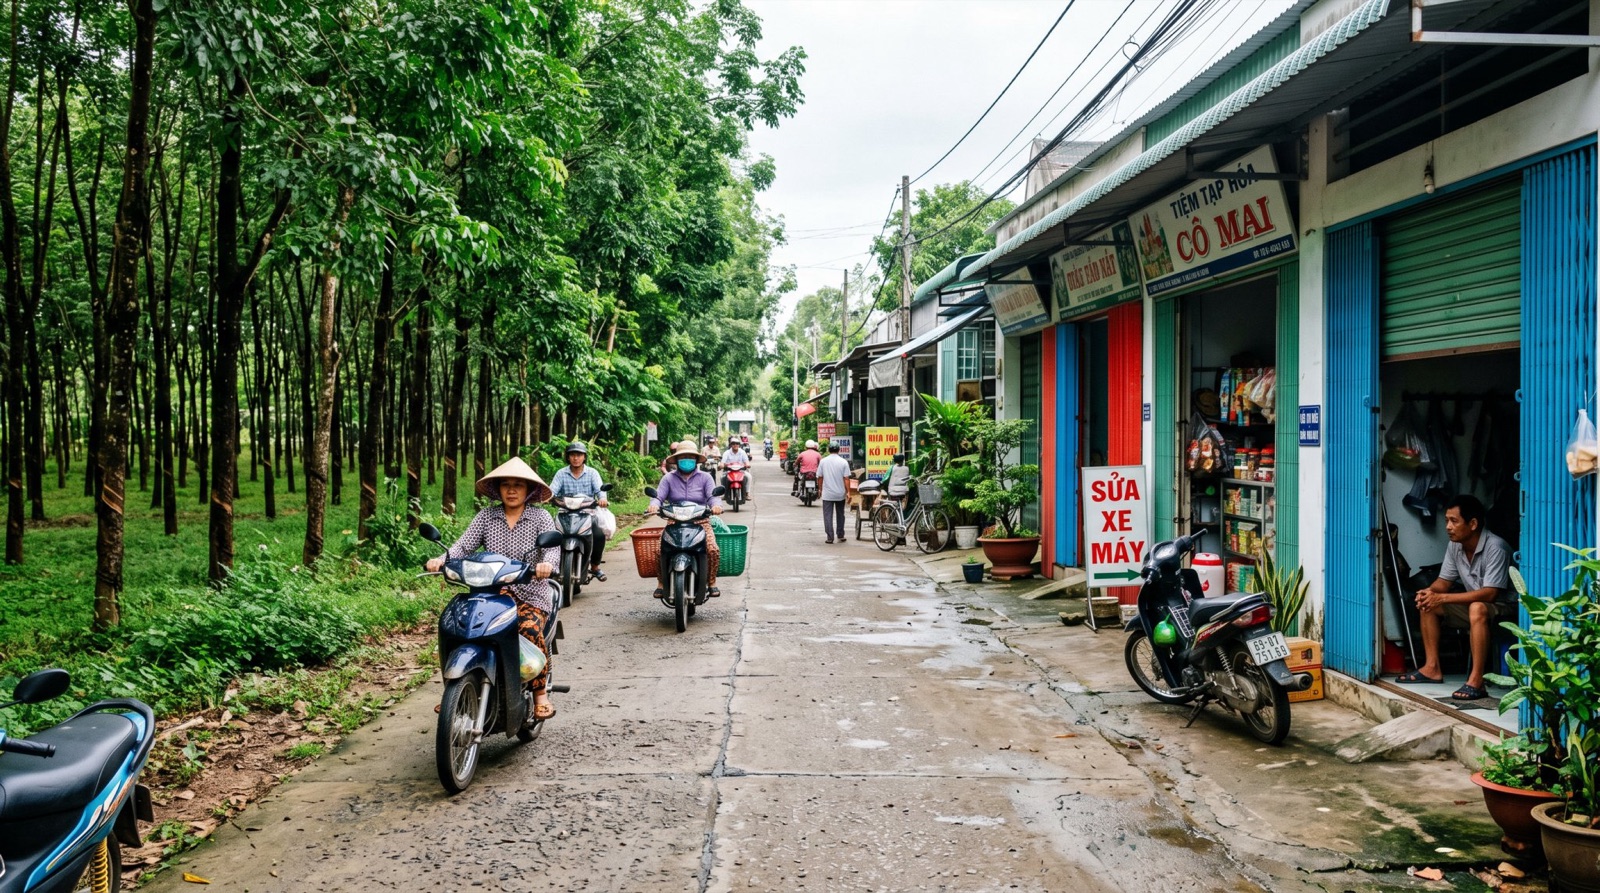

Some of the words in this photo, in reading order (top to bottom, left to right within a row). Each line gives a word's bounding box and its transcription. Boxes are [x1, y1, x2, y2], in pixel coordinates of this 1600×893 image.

[1170, 192, 1200, 219] TIỆM
[1199, 178, 1224, 206] TẠP
[1176, 216, 1209, 262] CÔ
[1213, 195, 1275, 249] MAI
[1091, 471, 1140, 502] SỬA
[1101, 510, 1132, 532] XE
[1091, 536, 1145, 564] MÁY
